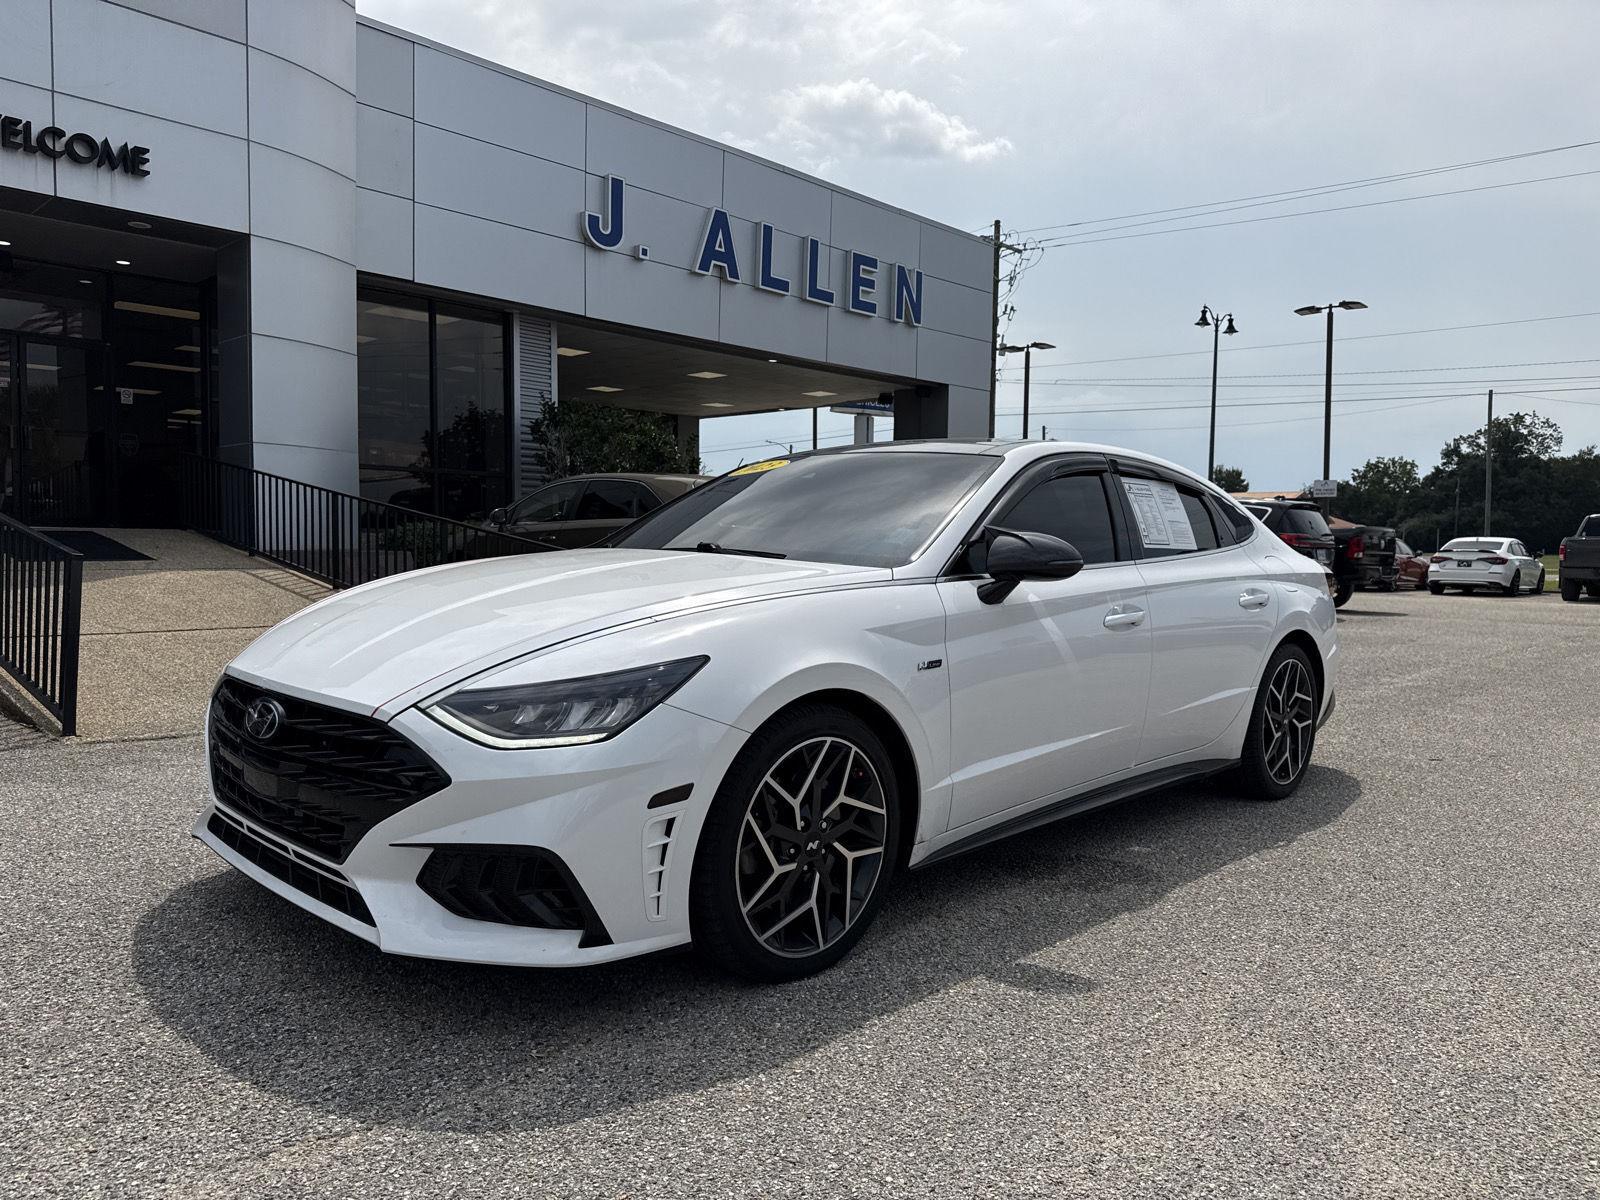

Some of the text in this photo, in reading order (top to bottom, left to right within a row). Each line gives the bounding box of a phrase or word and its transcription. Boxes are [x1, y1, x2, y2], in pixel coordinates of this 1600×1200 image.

[0, 114, 151, 177] ELCOME
[581, 173, 924, 327] J. ALLEN
